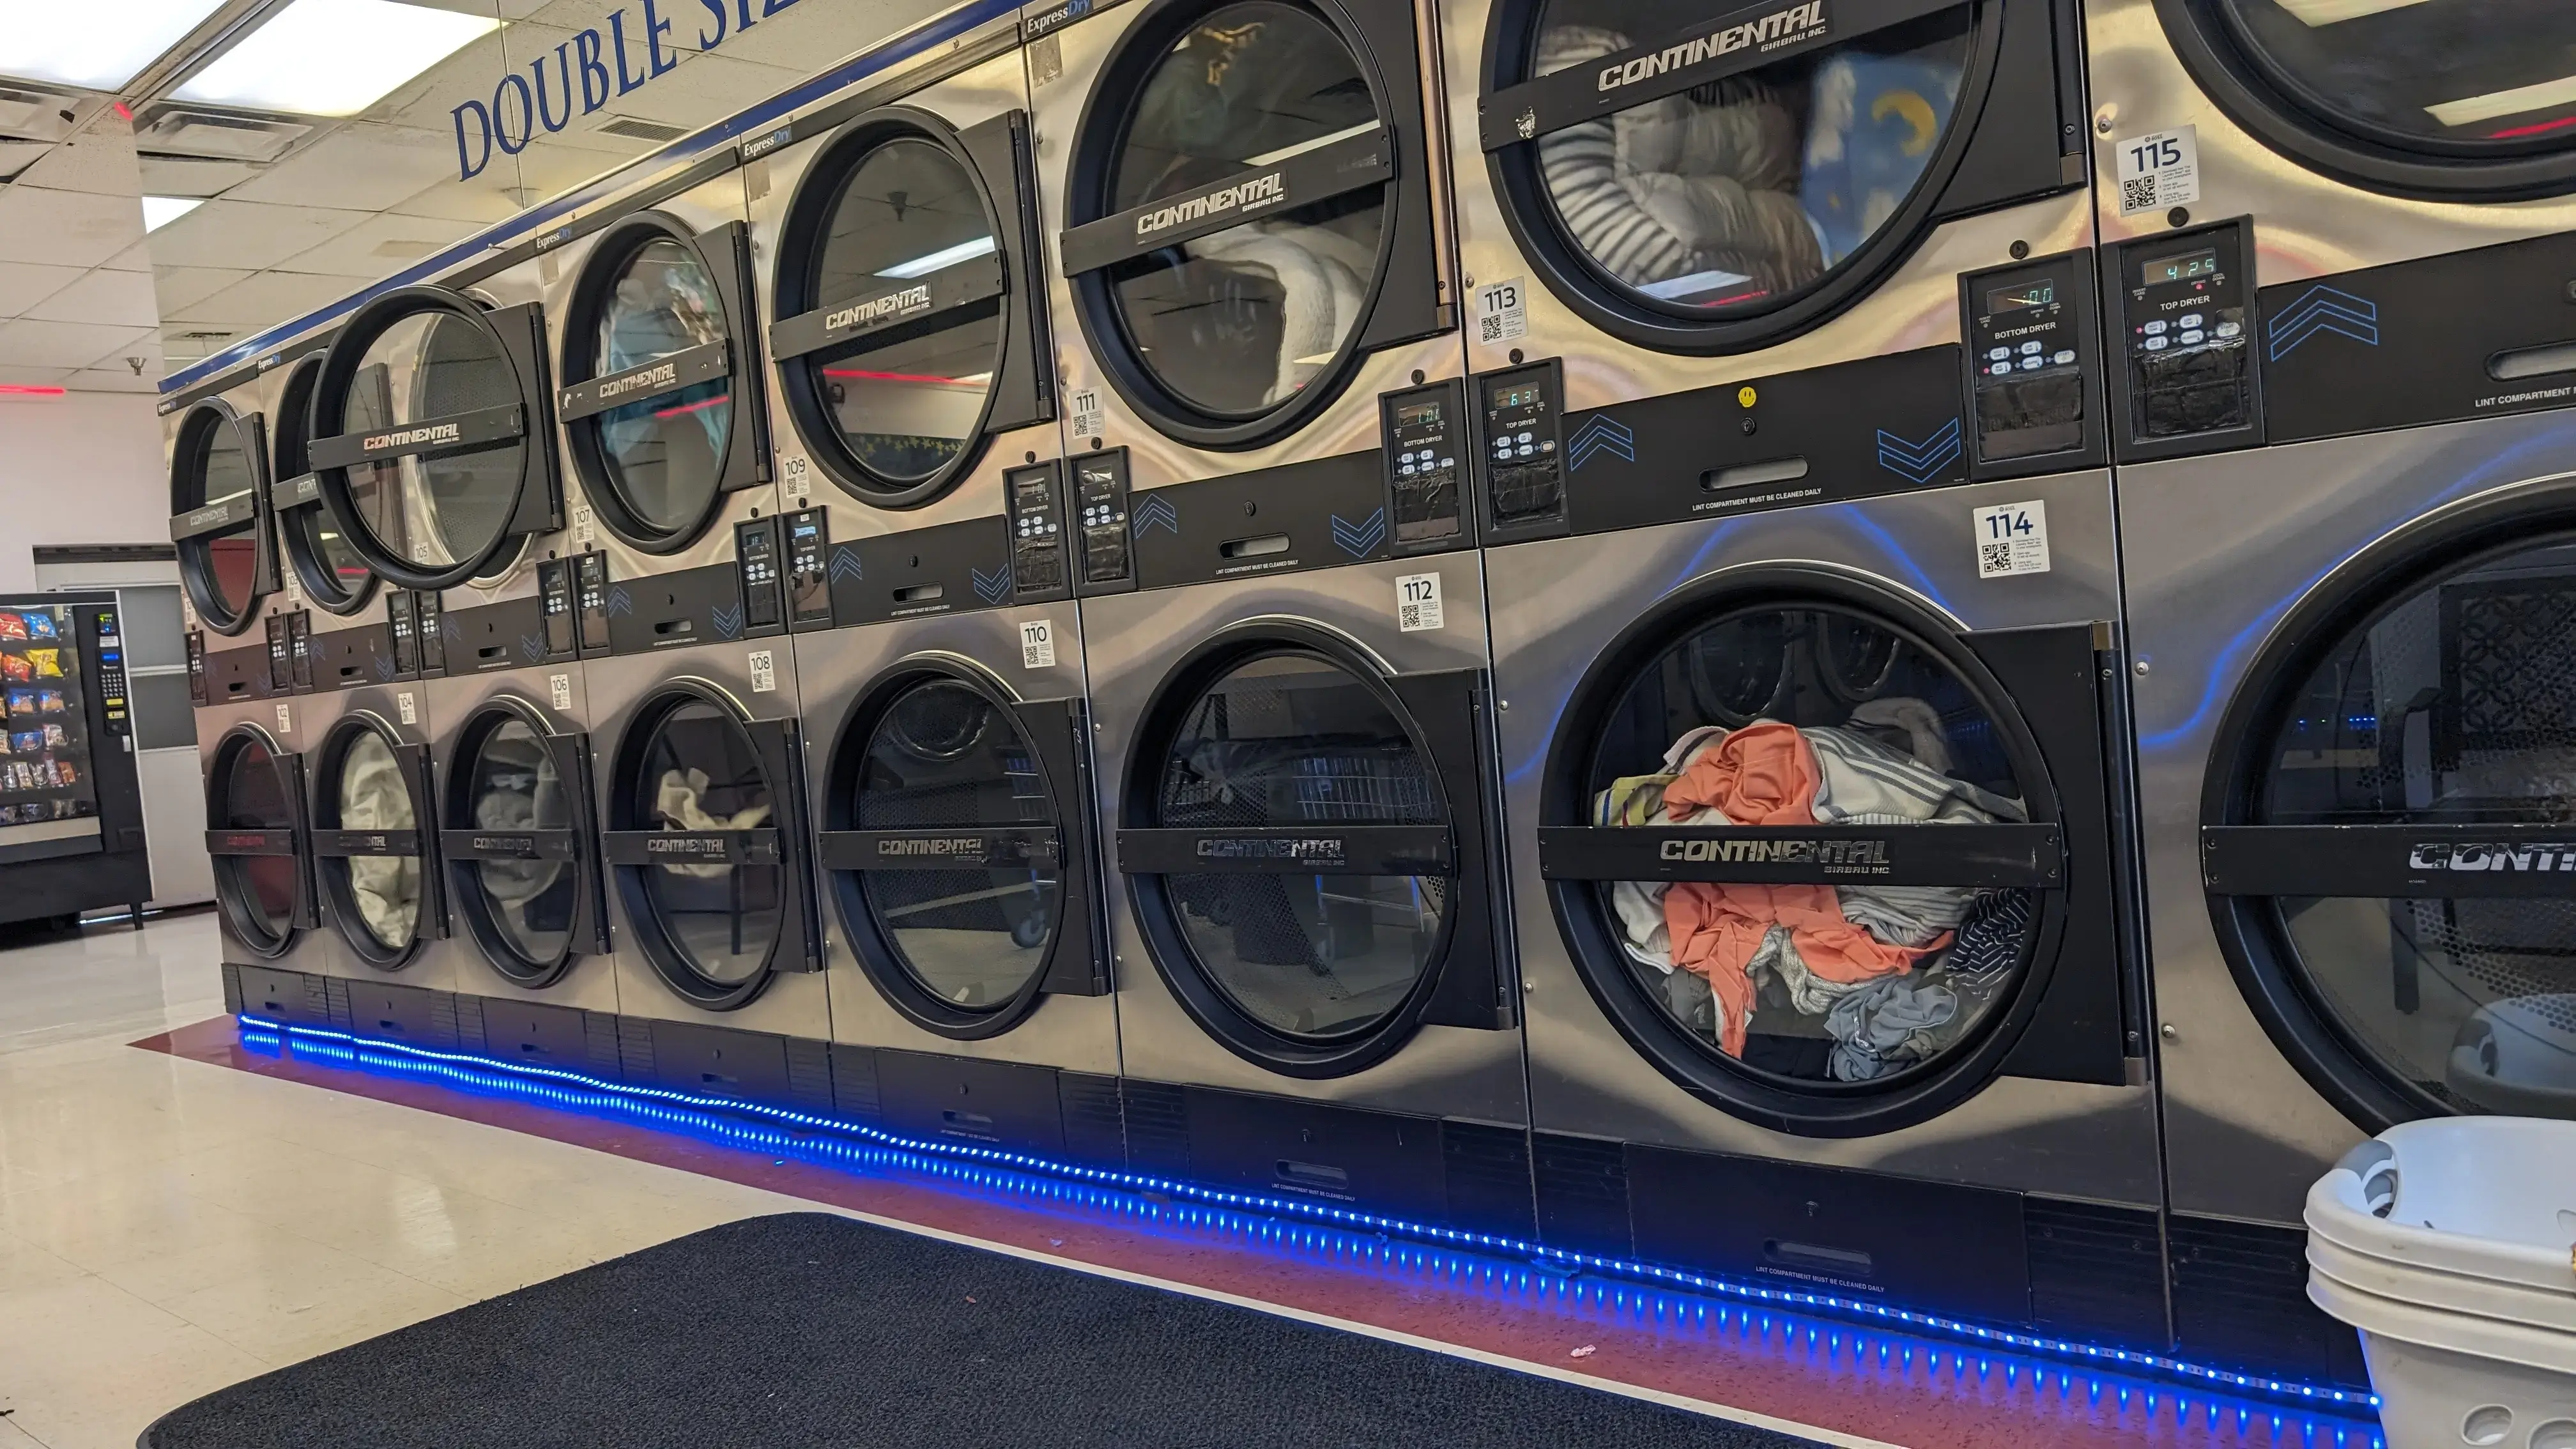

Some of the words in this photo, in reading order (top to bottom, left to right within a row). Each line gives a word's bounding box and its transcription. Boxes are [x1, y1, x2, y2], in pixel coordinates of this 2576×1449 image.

[1027, 0, 1090, 33] ExpressDry
[1598, 0, 1825, 91] CONTINENTAL
[450, 0, 676, 182] DOUBLE
[744, 129, 790, 156] ExpressDry
[2131, 138, 2181, 172] 115
[1137, 172, 1284, 234] CONTINENTAL
[537, 227, 571, 249] ExpressDry
[826, 285, 930, 330] CONTINENTAL
[1485, 287, 1516, 312] 113
[2160, 301, 2178, 310] TOP
[2180, 295, 2210, 307] DRYER
[1995, 326, 2028, 339] BOTTOM
[2029, 322, 2056, 333] DRYER
[600, 363, 676, 397] CONTINENTAL
[1077, 393, 1095, 412] 111
[2475, 397, 2496, 407] LINT
[2497, 387, 2571, 404] COMPARTMENT
[1518, 418, 1537, 427] DRYER
[364, 424, 459, 450] CONTINENTAL
[1404, 438, 1425, 447] BOTTOM
[1425, 435, 1443, 443] DRYER
[786, 459, 806, 476] 109
[1706, 498, 1748, 509] COMPARTMENT
[1775, 491, 1804, 500] CLEANED
[575, 509, 590, 524] 107
[1986, 511, 2034, 539] 114
[416, 549, 427, 559] 105
[288, 576, 298, 586] 103
[1404, 580, 1432, 601] 112
[1025, 626, 1046, 643] 110
[751, 656, 770, 671] 108
[553, 678, 567, 691] 106
[400, 695, 412, 709] 104
[278, 708, 288, 717] 102
[647, 839, 726, 852] CONTINENTAL
[878, 839, 984, 855] CONTINENTAL
[1197, 839, 1344, 857] CONTINENTAL
[1660, 840, 1889, 863] CONTINENTAL
[2409, 843, 2576, 871] CONTI
[1769, 1268, 1811, 1280] COMPARTMENT
[1839, 1280, 1867, 1290] CLEANED
[1868, 1284, 1884, 1292] DAILY
